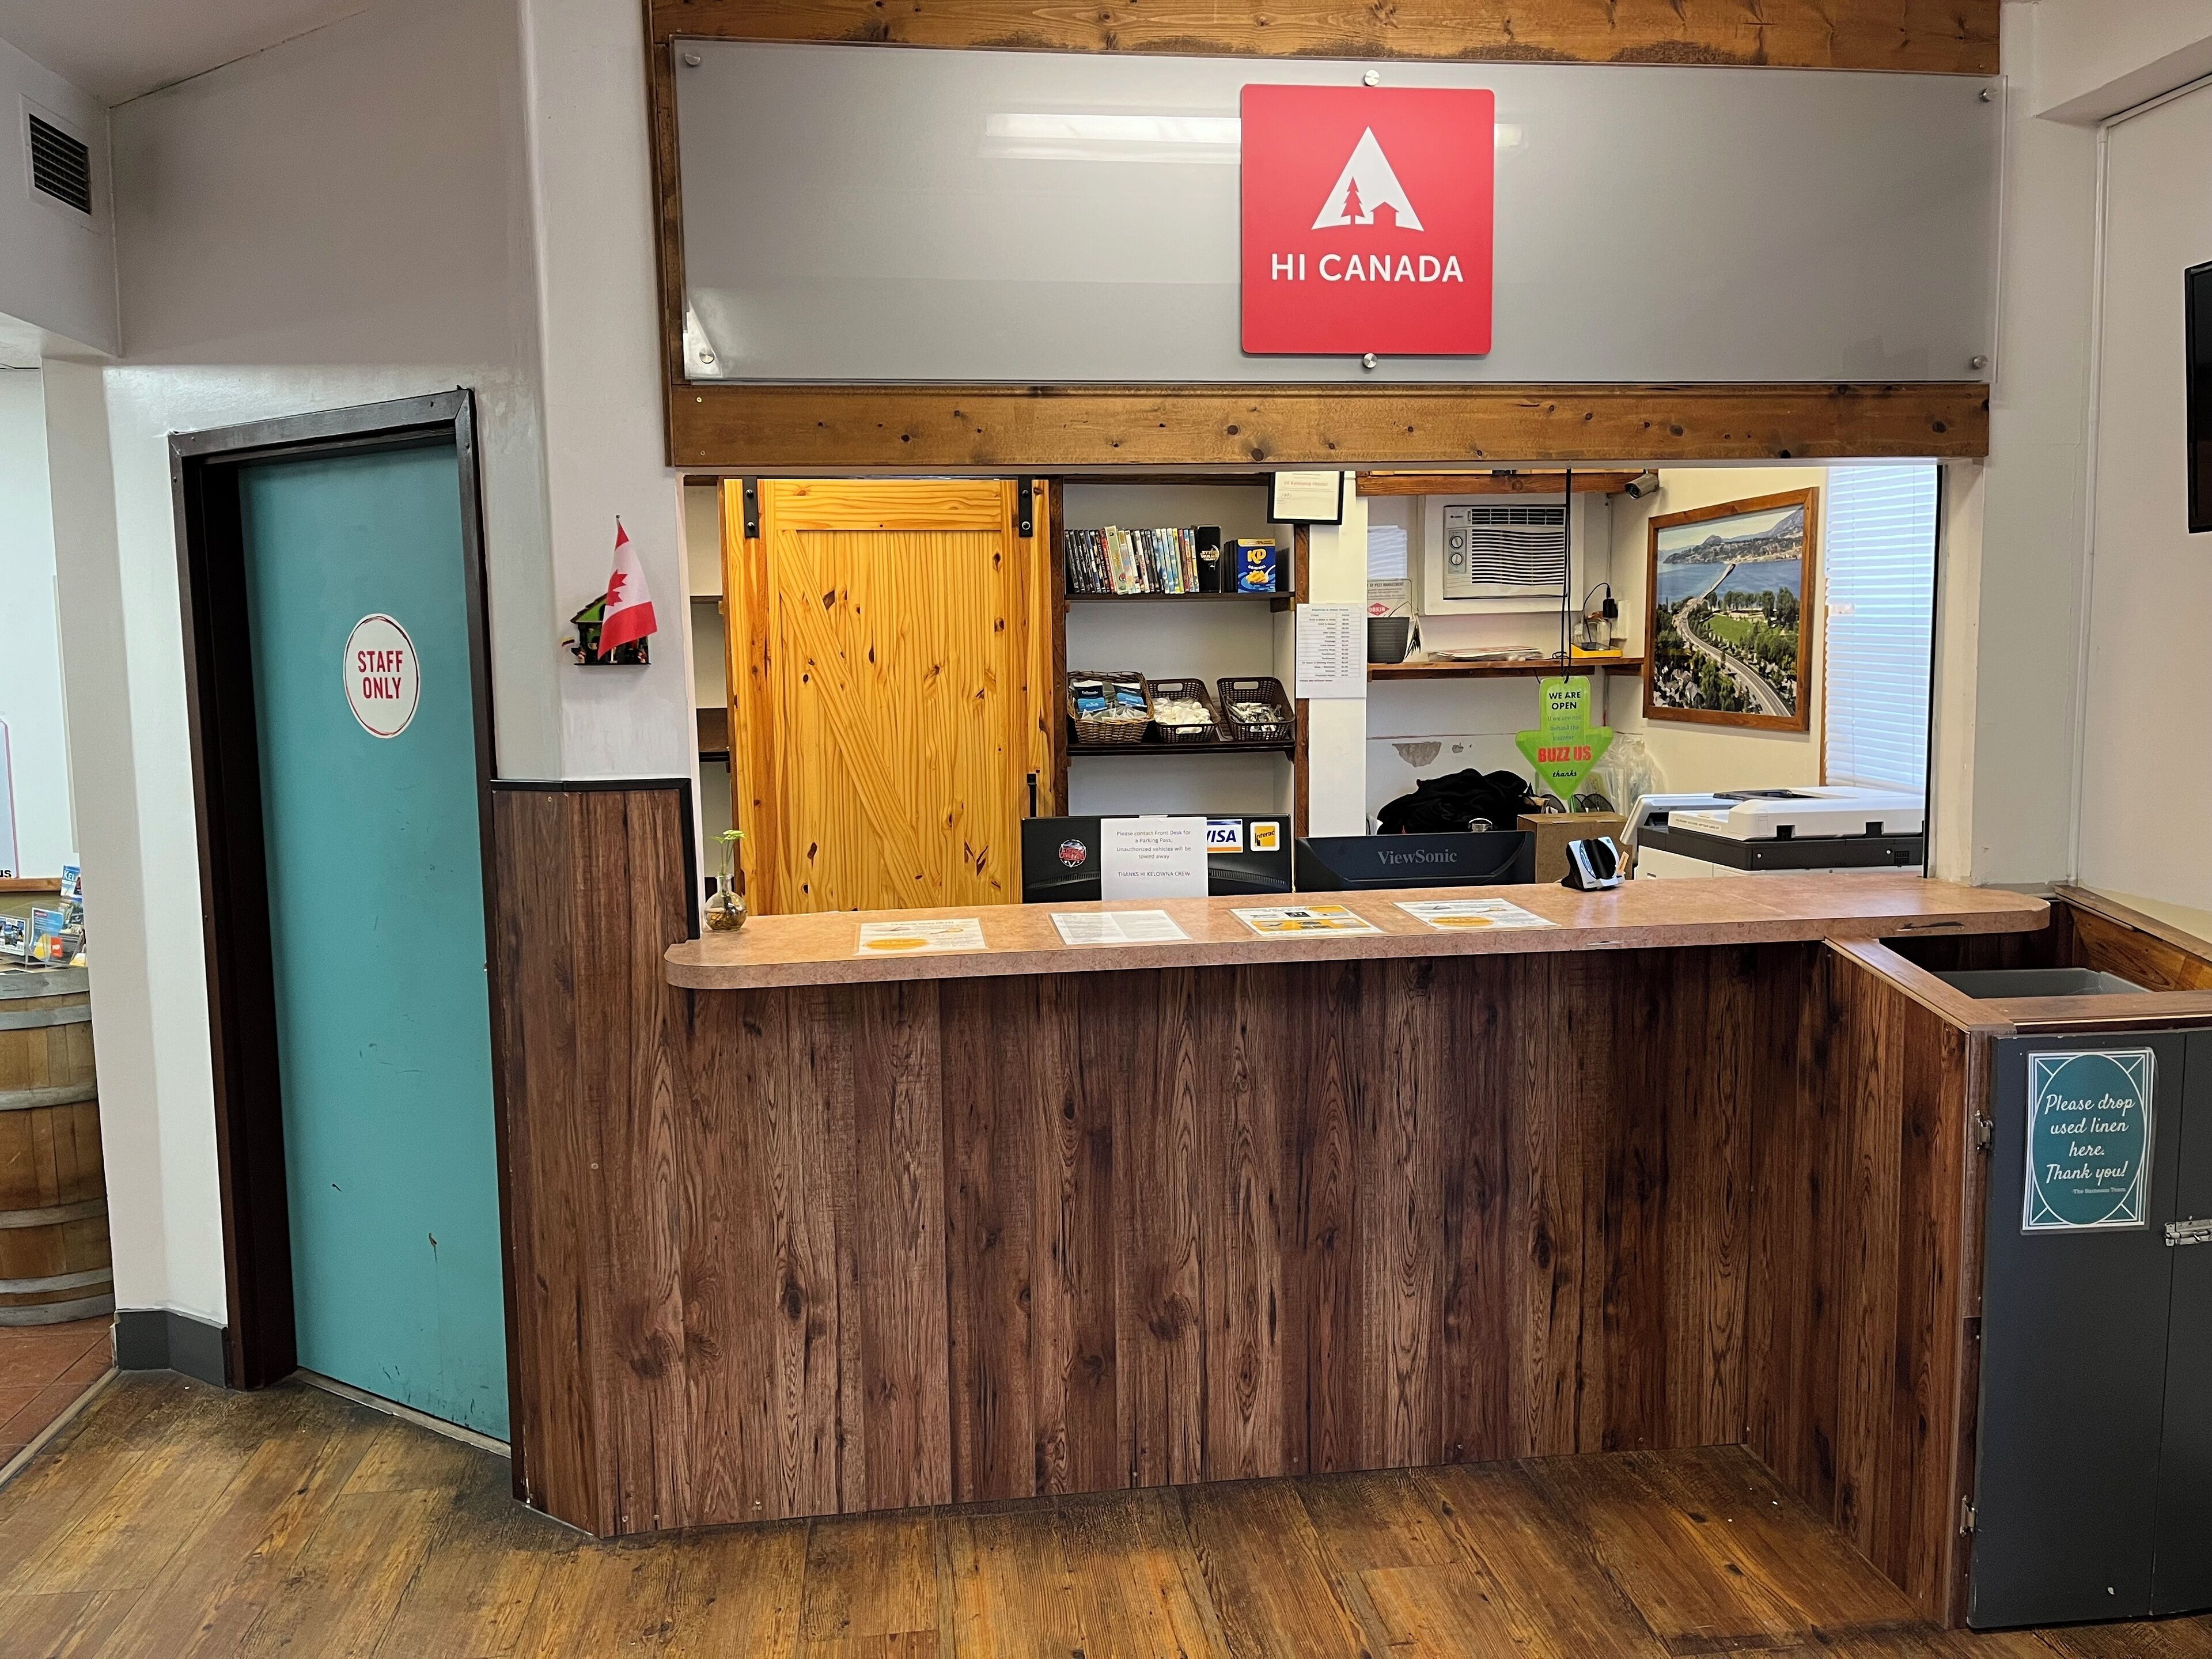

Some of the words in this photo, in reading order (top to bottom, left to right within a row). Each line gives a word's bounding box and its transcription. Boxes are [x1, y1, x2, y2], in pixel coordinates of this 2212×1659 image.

[1271, 253, 1305, 281] HI
[1319, 253, 1464, 282] CANADA
[1247, 548, 1267, 565] KD
[357, 650, 403, 673] STAFF
[362, 676, 402, 699] ONLY
[1551, 702, 1577, 710] OPEN
[1537, 747, 1571, 763] BUZZ
[1573, 746, 1592, 761] US
[1255, 831, 1275, 842] Interac
[1378, 849, 1457, 865] ViewSonic
[2045, 1094, 2094, 1115] Please
[2098, 1093, 2135, 1116] drop
[2050, 1118, 2086, 1135] used
[2090, 1118, 2129, 1133] linen
[2069, 1142, 2105, 1157] here.
[2046, 1164, 2092, 1183] Thank
[2096, 1160, 2128, 1185] you!
